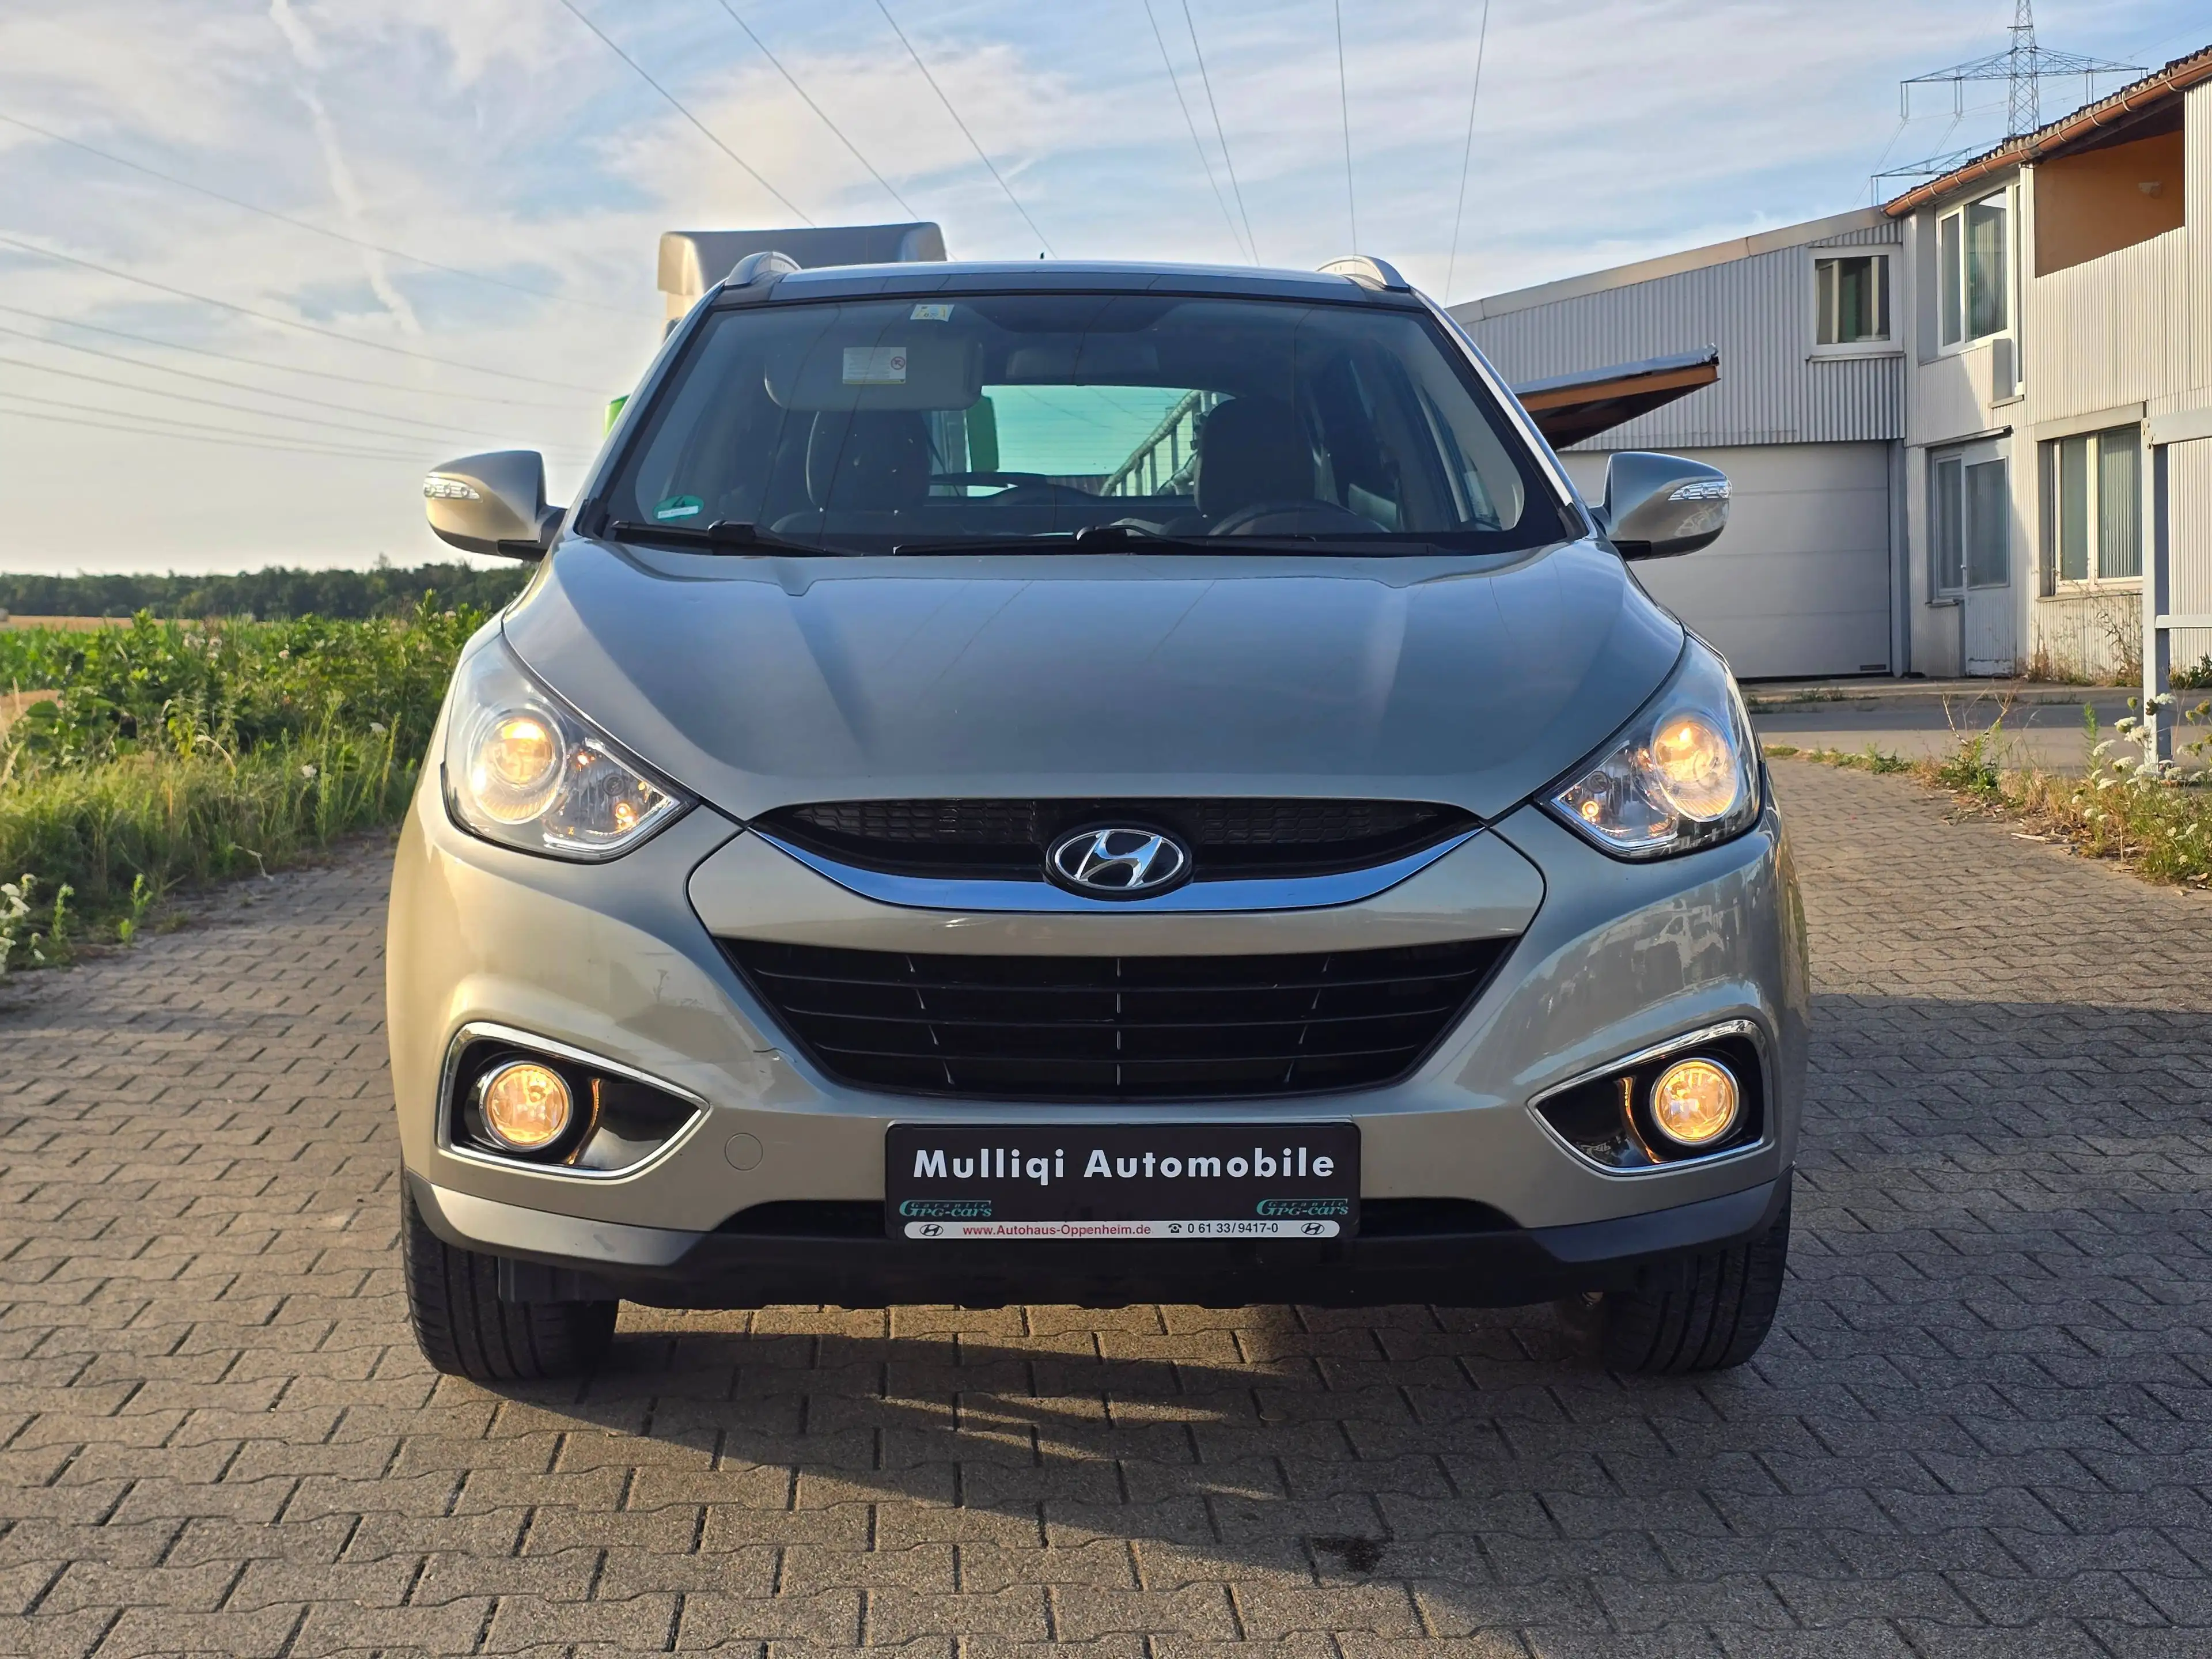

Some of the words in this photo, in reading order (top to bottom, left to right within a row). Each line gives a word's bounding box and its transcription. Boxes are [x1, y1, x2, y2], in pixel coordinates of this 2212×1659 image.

[913, 1148, 1064, 1185] Mulliqi
[1084, 1147, 1335, 1178] Automobile
[963, 1224, 1151, 1237] www.Autohaus-Oppenheim.de
[1187, 1224, 1195, 1233] 0
[1199, 1223, 1211, 1233] 61
[1217, 1222, 1279, 1233] 33/9417-0
